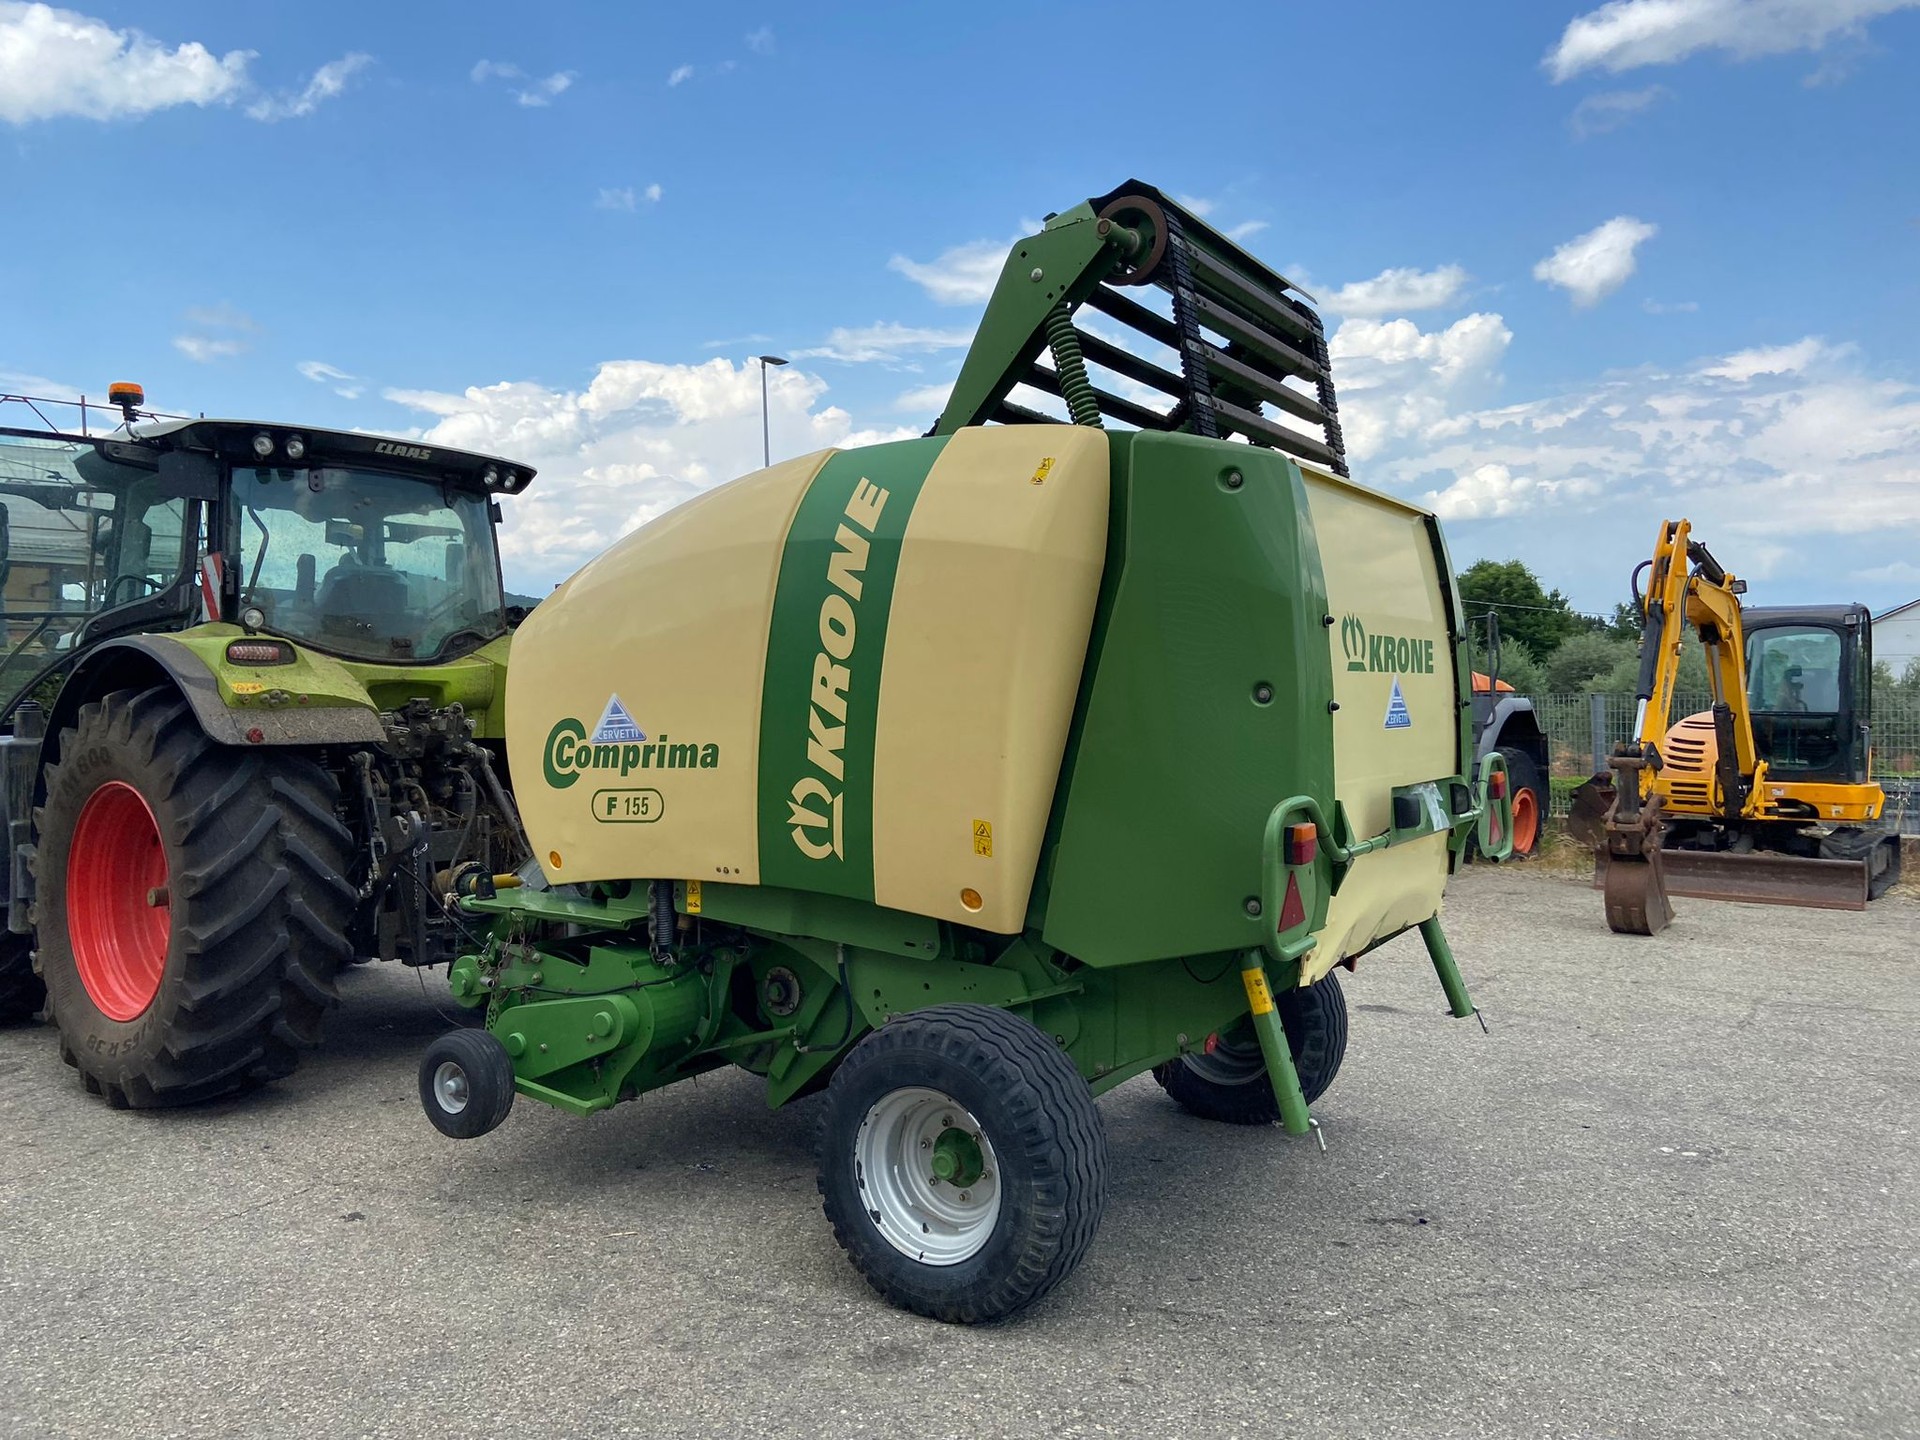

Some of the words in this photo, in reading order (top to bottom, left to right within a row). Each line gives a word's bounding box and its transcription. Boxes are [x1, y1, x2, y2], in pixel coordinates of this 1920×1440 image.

[375, 442, 431, 460] CLAAS
[807, 476, 890, 782] KRONE
[1368, 634, 1434, 674] KRONE
[597, 728, 639, 740] CERVETTI
[606, 796, 618, 815] F
[624, 796, 649, 815] 155
